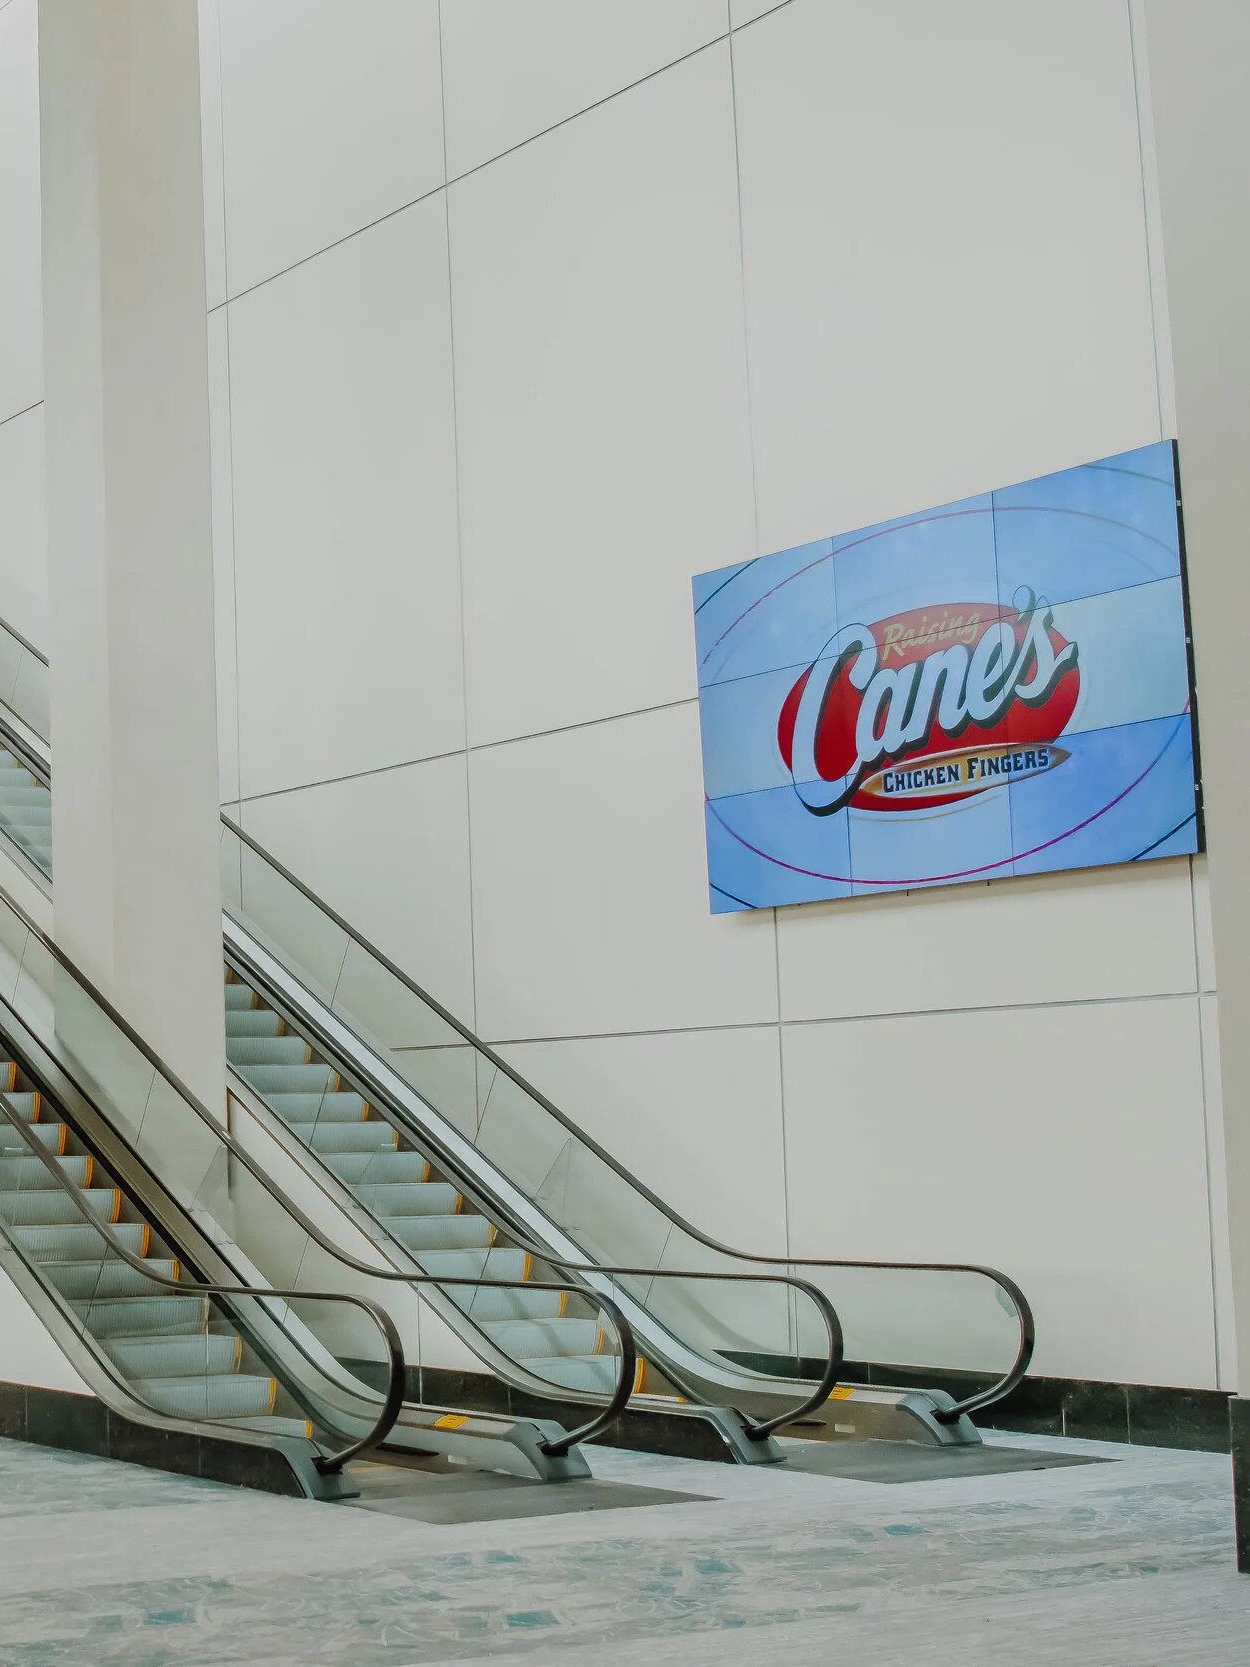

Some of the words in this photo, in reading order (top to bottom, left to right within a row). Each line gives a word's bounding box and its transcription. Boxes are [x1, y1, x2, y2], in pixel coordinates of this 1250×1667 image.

[882, 611, 980, 661] Raising
[791, 584, 1079, 817] Cane's
[882, 763, 960, 793] CHICKEN
[966, 748, 1050, 780] FINGERS
